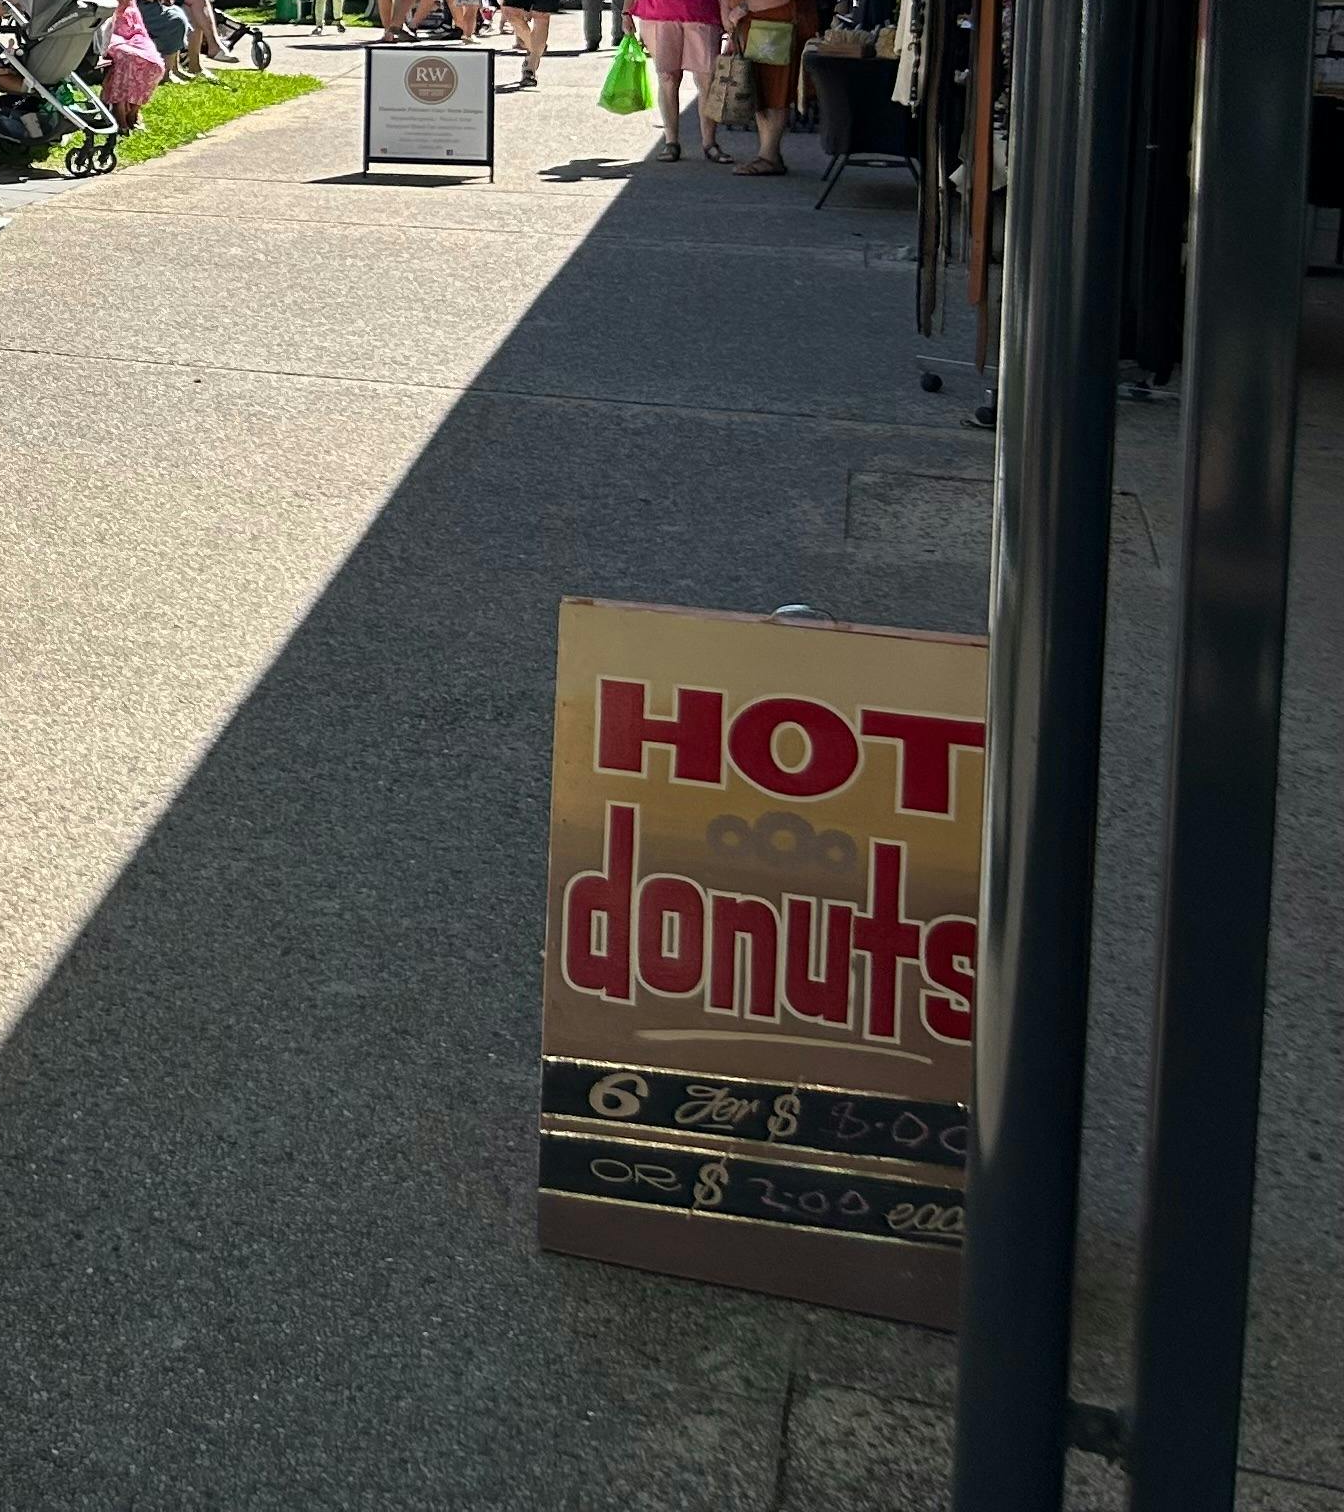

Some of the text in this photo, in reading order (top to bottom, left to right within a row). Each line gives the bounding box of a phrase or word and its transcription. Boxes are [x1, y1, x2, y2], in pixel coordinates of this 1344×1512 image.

[415, 67, 448, 82] RW
[595, 676, 985, 819] HOT
[563, 801, 977, 1045] donuts
[589, 1072, 649, 1117] 6
[589, 1158, 682, 1192] OR
